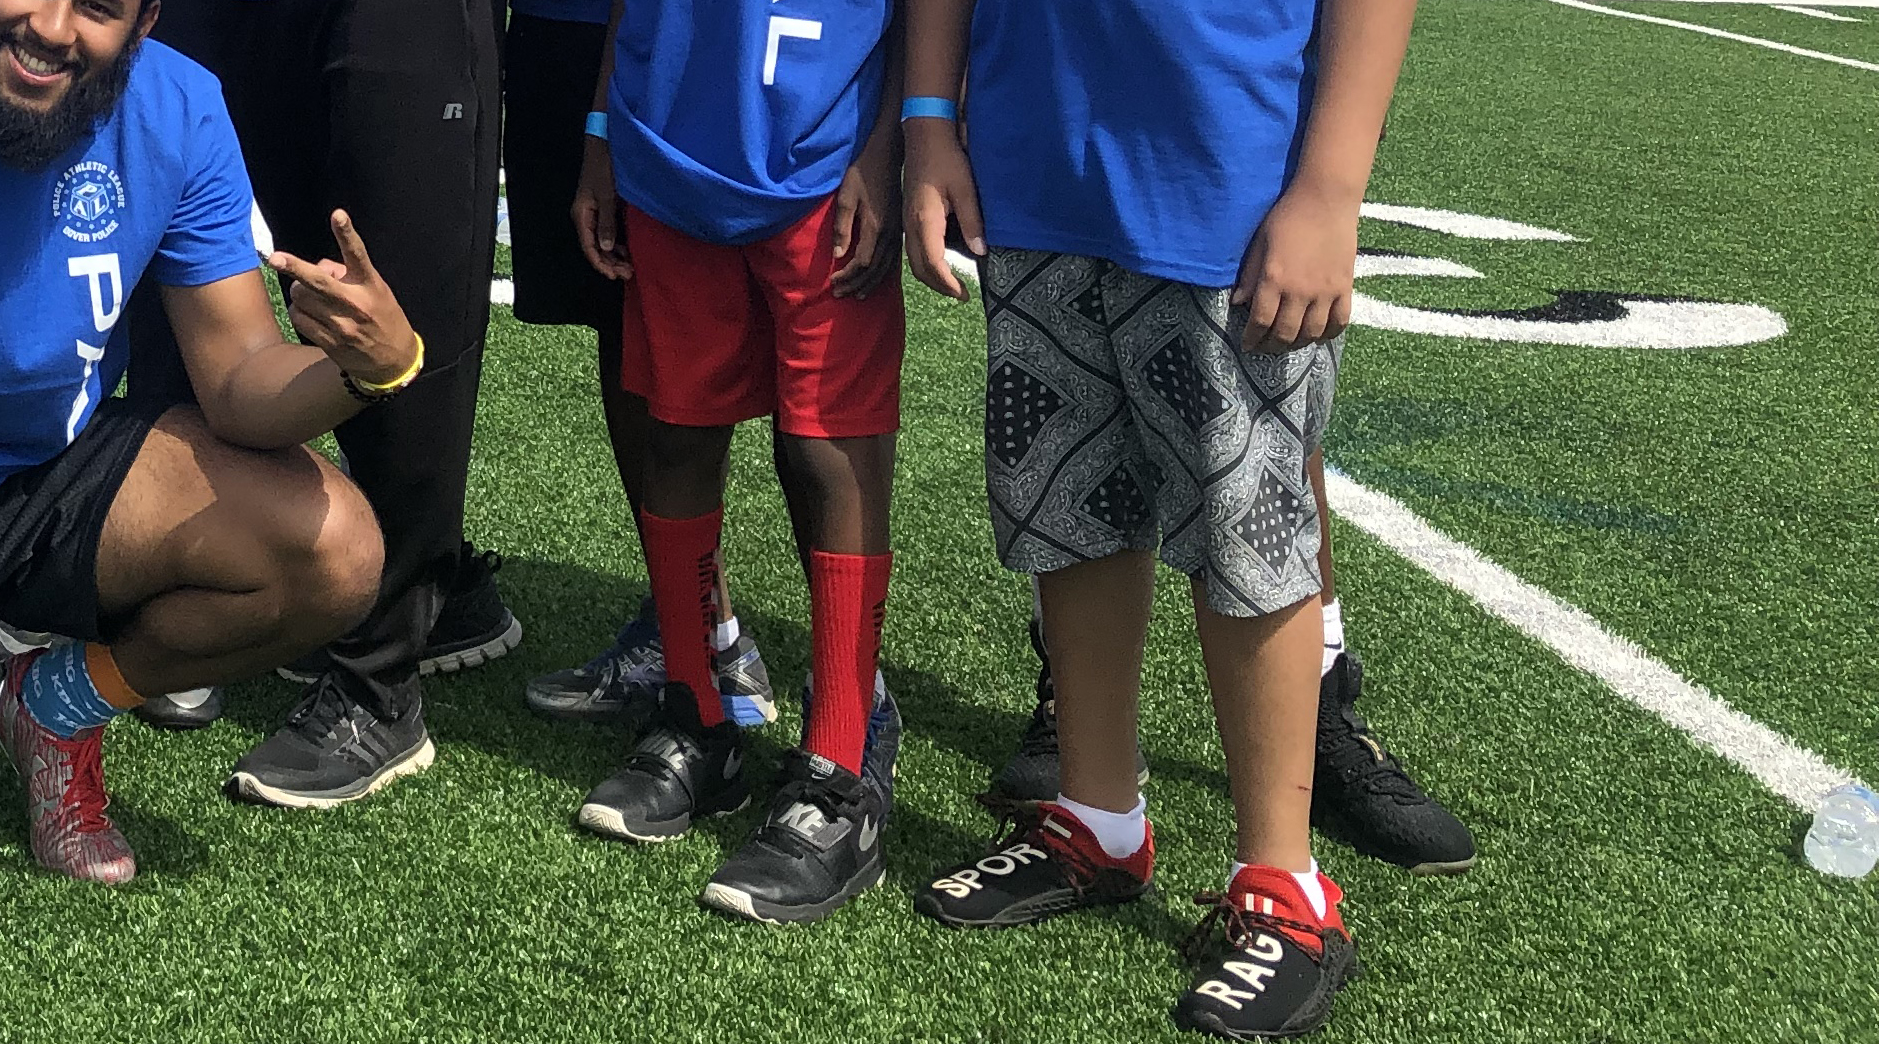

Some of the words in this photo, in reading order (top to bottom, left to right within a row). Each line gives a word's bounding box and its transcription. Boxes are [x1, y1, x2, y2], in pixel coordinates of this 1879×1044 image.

[52, 180, 65, 217] POLICE
[63, 160, 108, 181] ATHLETIC
[108, 169, 125, 208] LEAGUE
[62, 226, 91, 242] DOVER
[92, 220, 120, 242] POLICE
